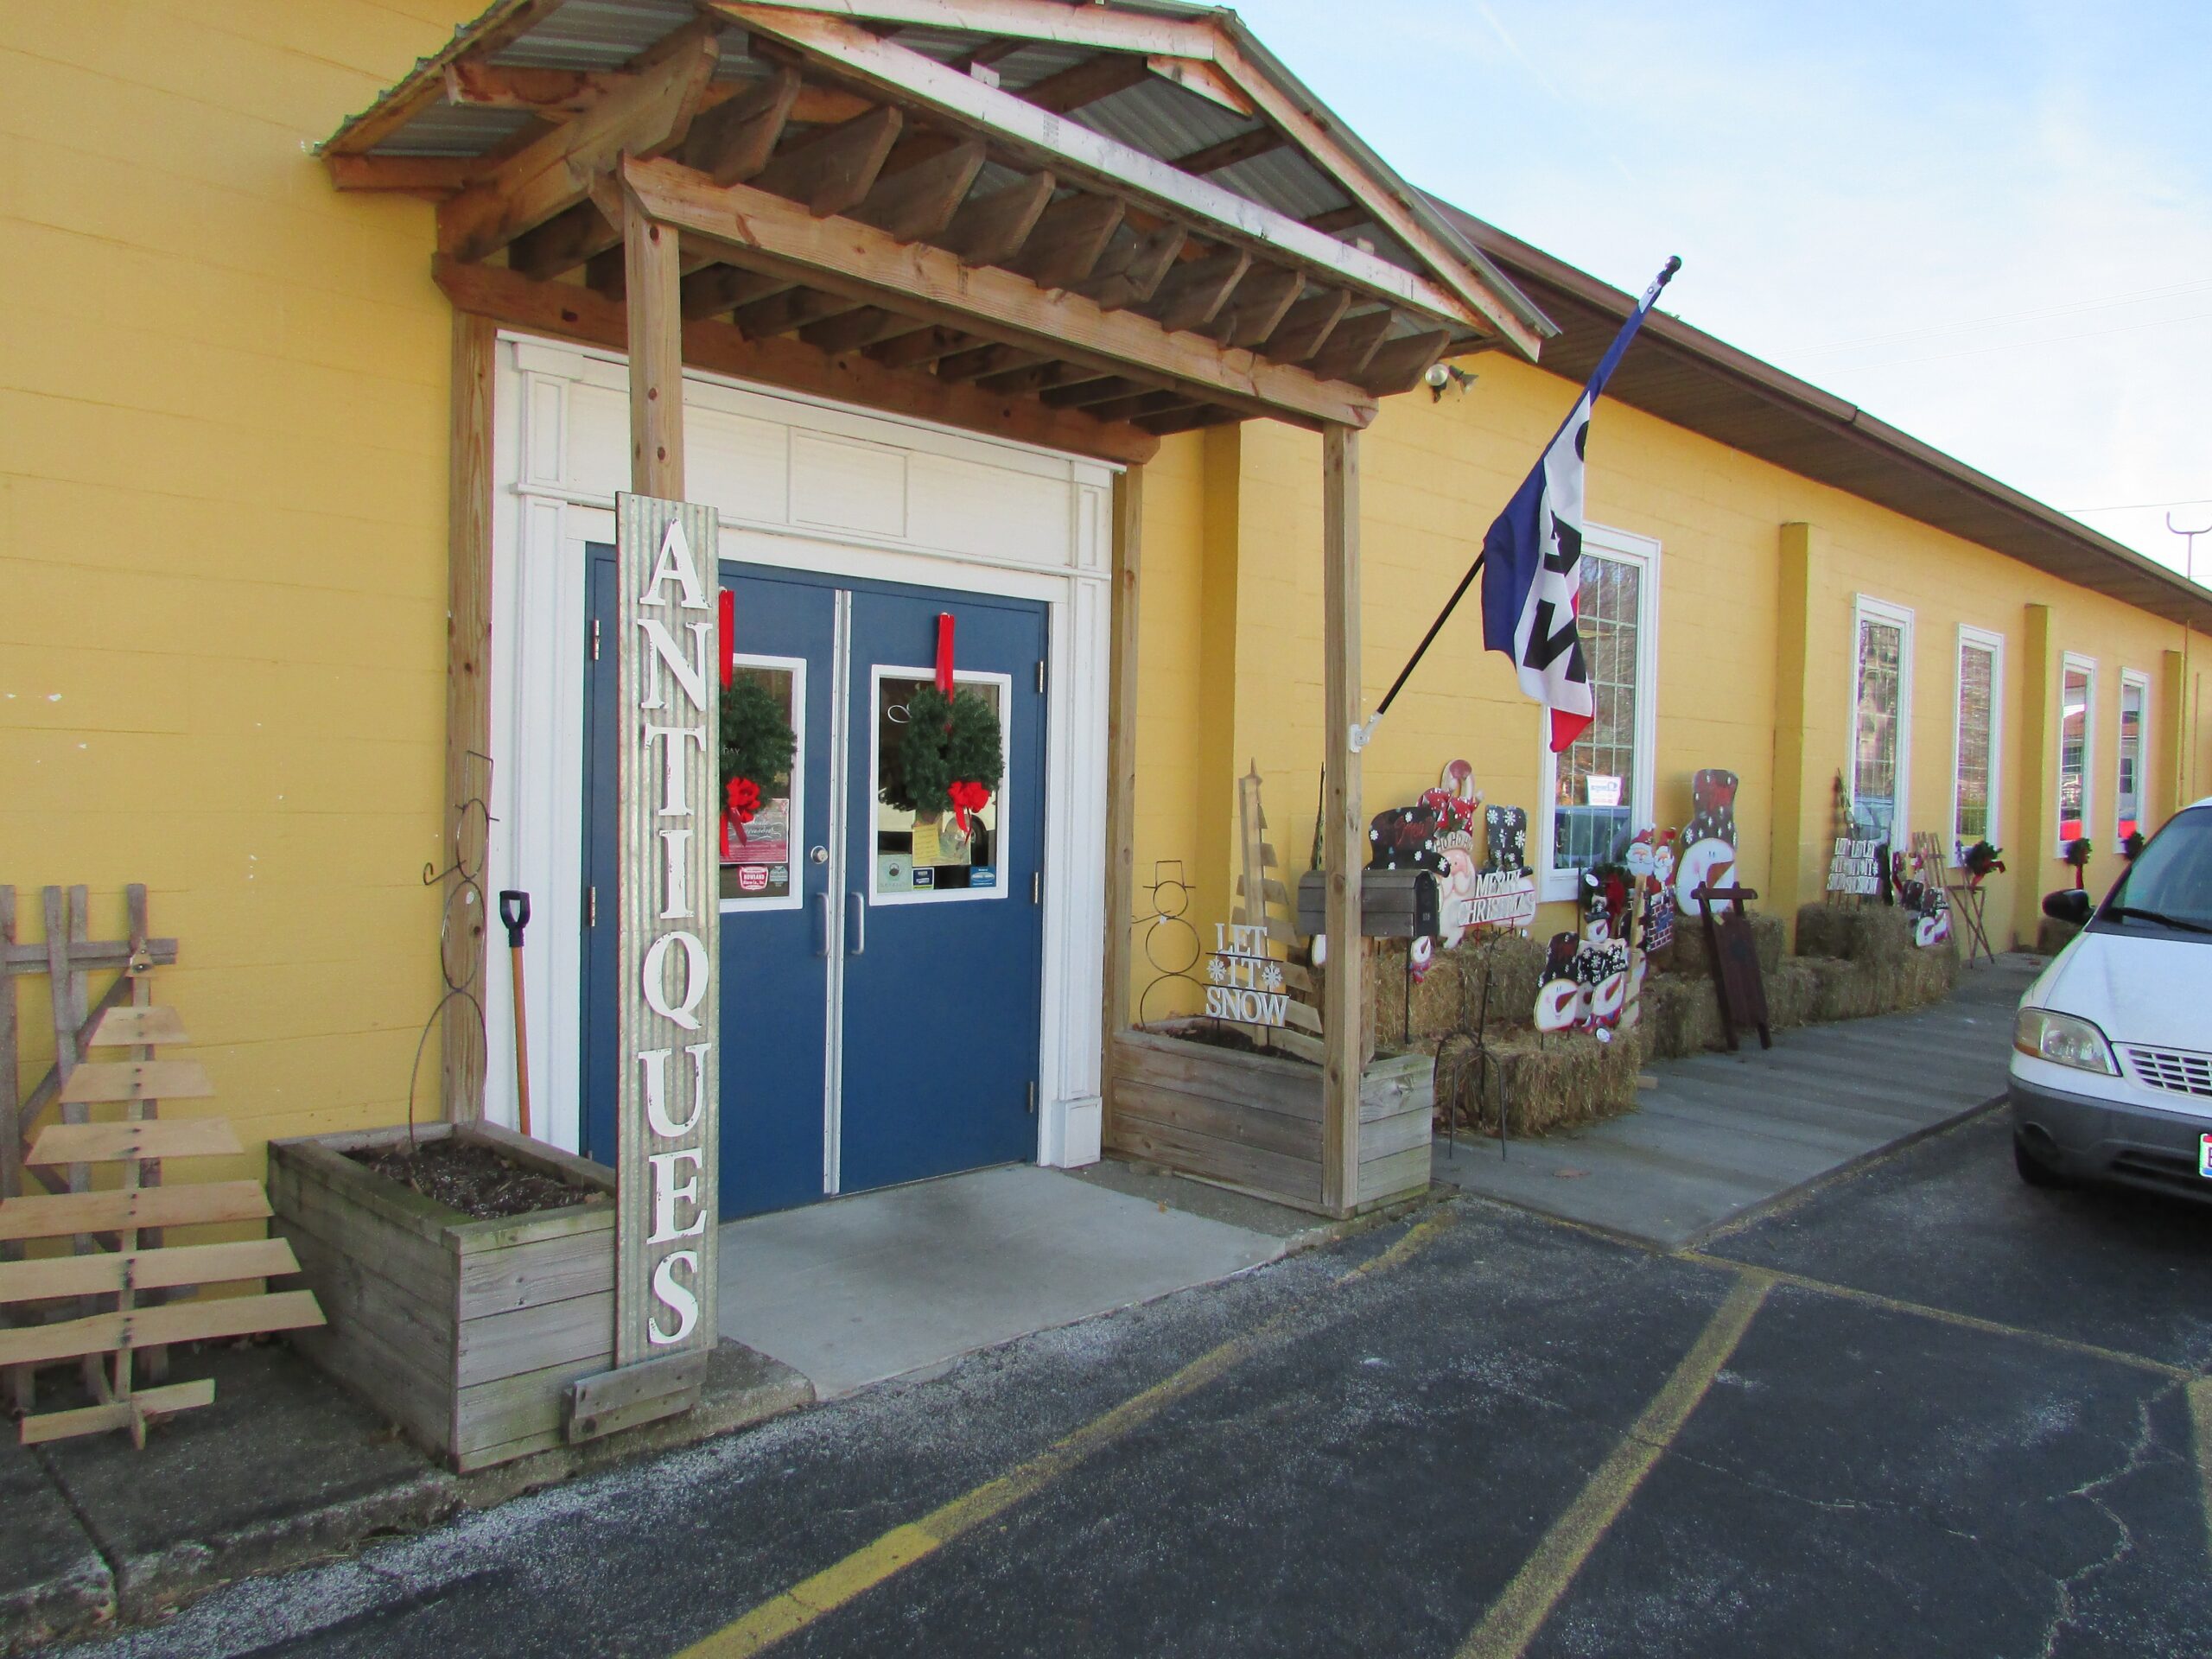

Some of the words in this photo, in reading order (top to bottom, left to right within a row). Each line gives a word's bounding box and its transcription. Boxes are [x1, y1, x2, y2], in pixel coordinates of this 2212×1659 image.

[1451, 834, 1462, 846] HO
[638, 518, 713, 1344] ANTIQUES
[1215, 923, 1268, 958] LET
[1228, 956, 1262, 990] IT
[1206, 986, 1289, 1027] SNOW
